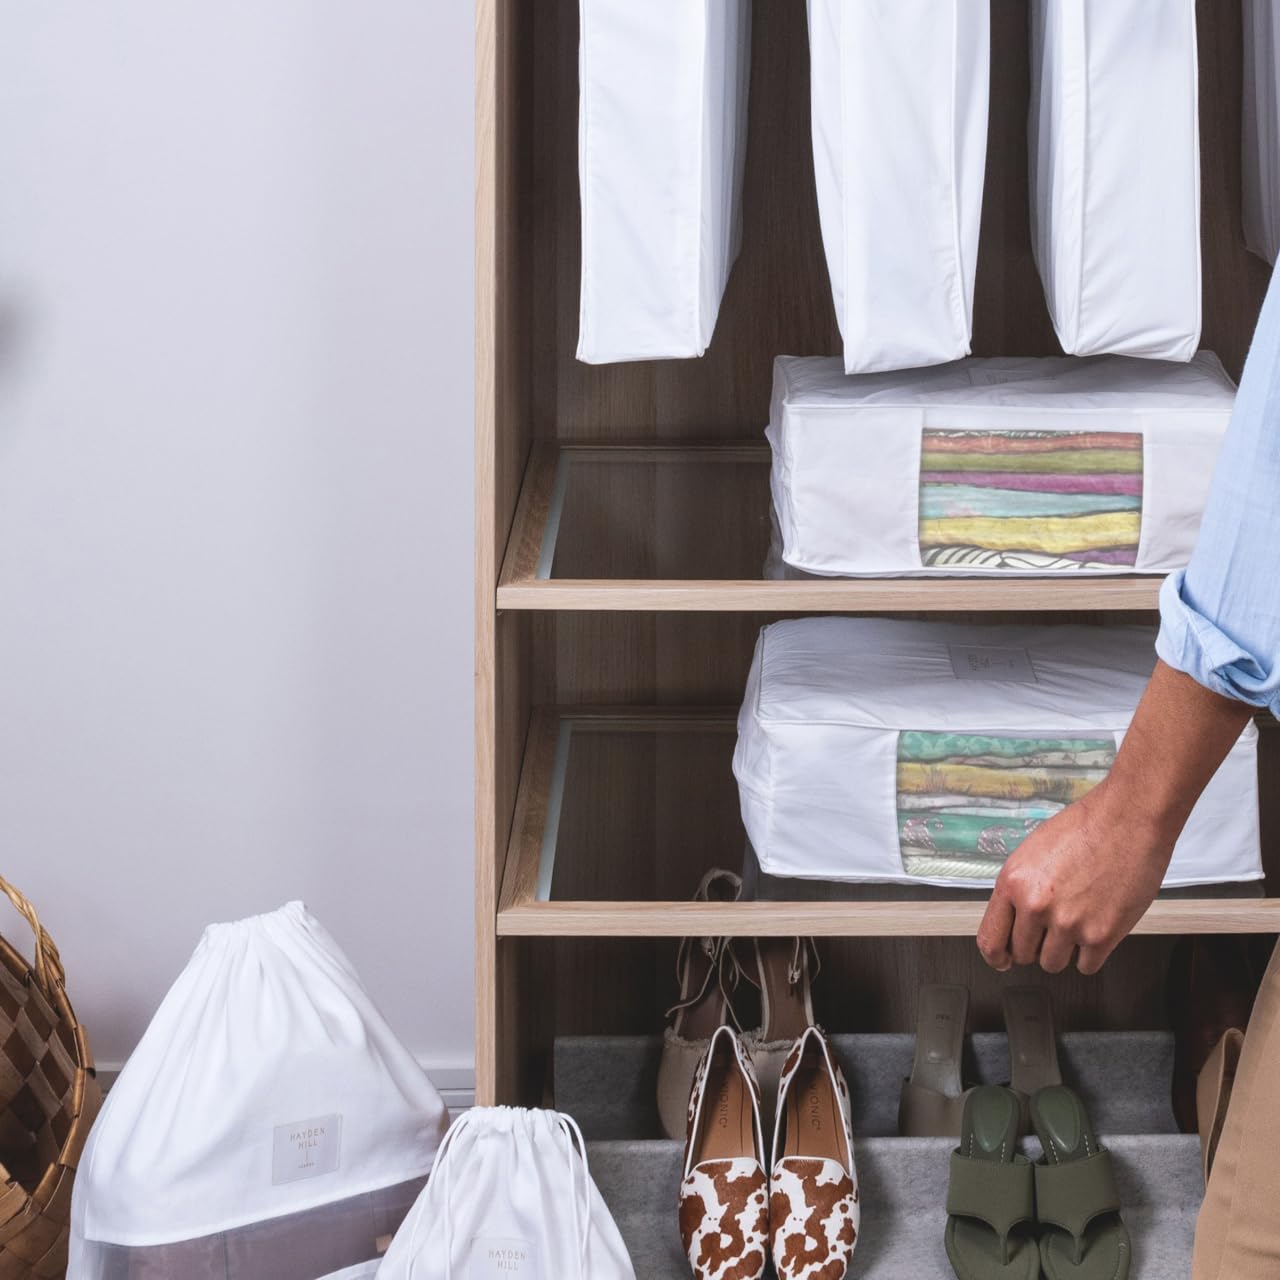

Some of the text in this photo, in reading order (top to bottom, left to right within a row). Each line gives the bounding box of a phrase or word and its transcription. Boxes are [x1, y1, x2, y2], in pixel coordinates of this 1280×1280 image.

[290, 1128, 327, 1142] HAYDEN
[297, 1138, 318, 1150] HILL
[488, 1249, 527, 1261] HAYDEN
[497, 1260, 519, 1271] HILL
